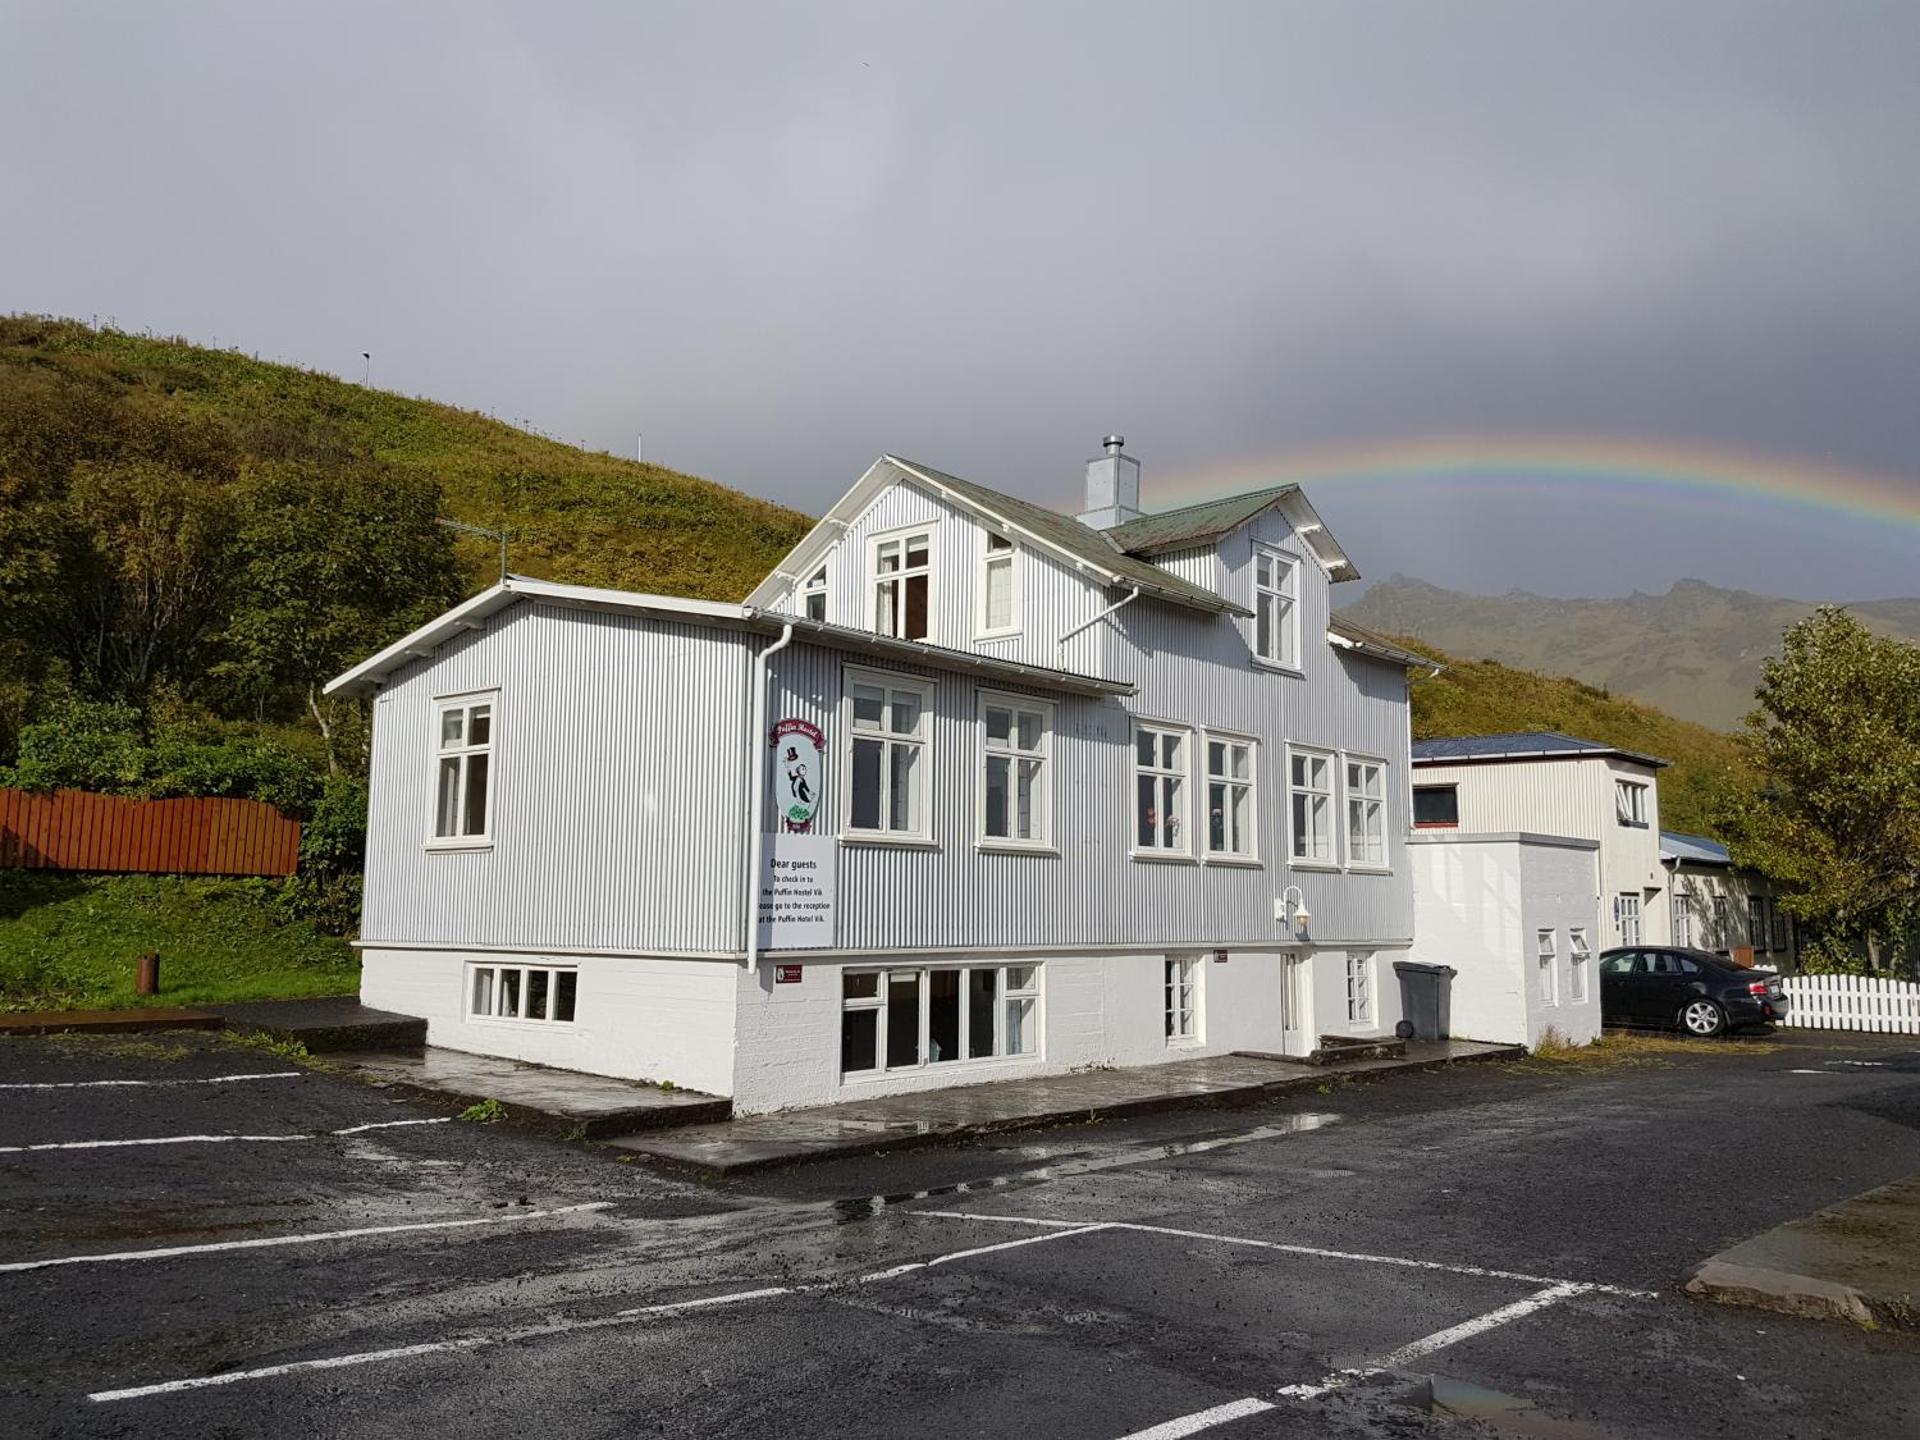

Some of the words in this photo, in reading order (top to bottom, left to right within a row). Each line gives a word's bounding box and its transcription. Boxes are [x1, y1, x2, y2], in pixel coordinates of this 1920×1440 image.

[770, 858, 789, 869] Dear
[791, 860, 816, 871] guests
[762, 887, 772, 896] the
[774, 888, 792, 896] Puffin
[793, 888, 812, 896] Hostel
[775, 903, 783, 911] go
[791, 902, 802, 910] the
[803, 902, 830, 911] reception
[766, 915, 776, 923] the
